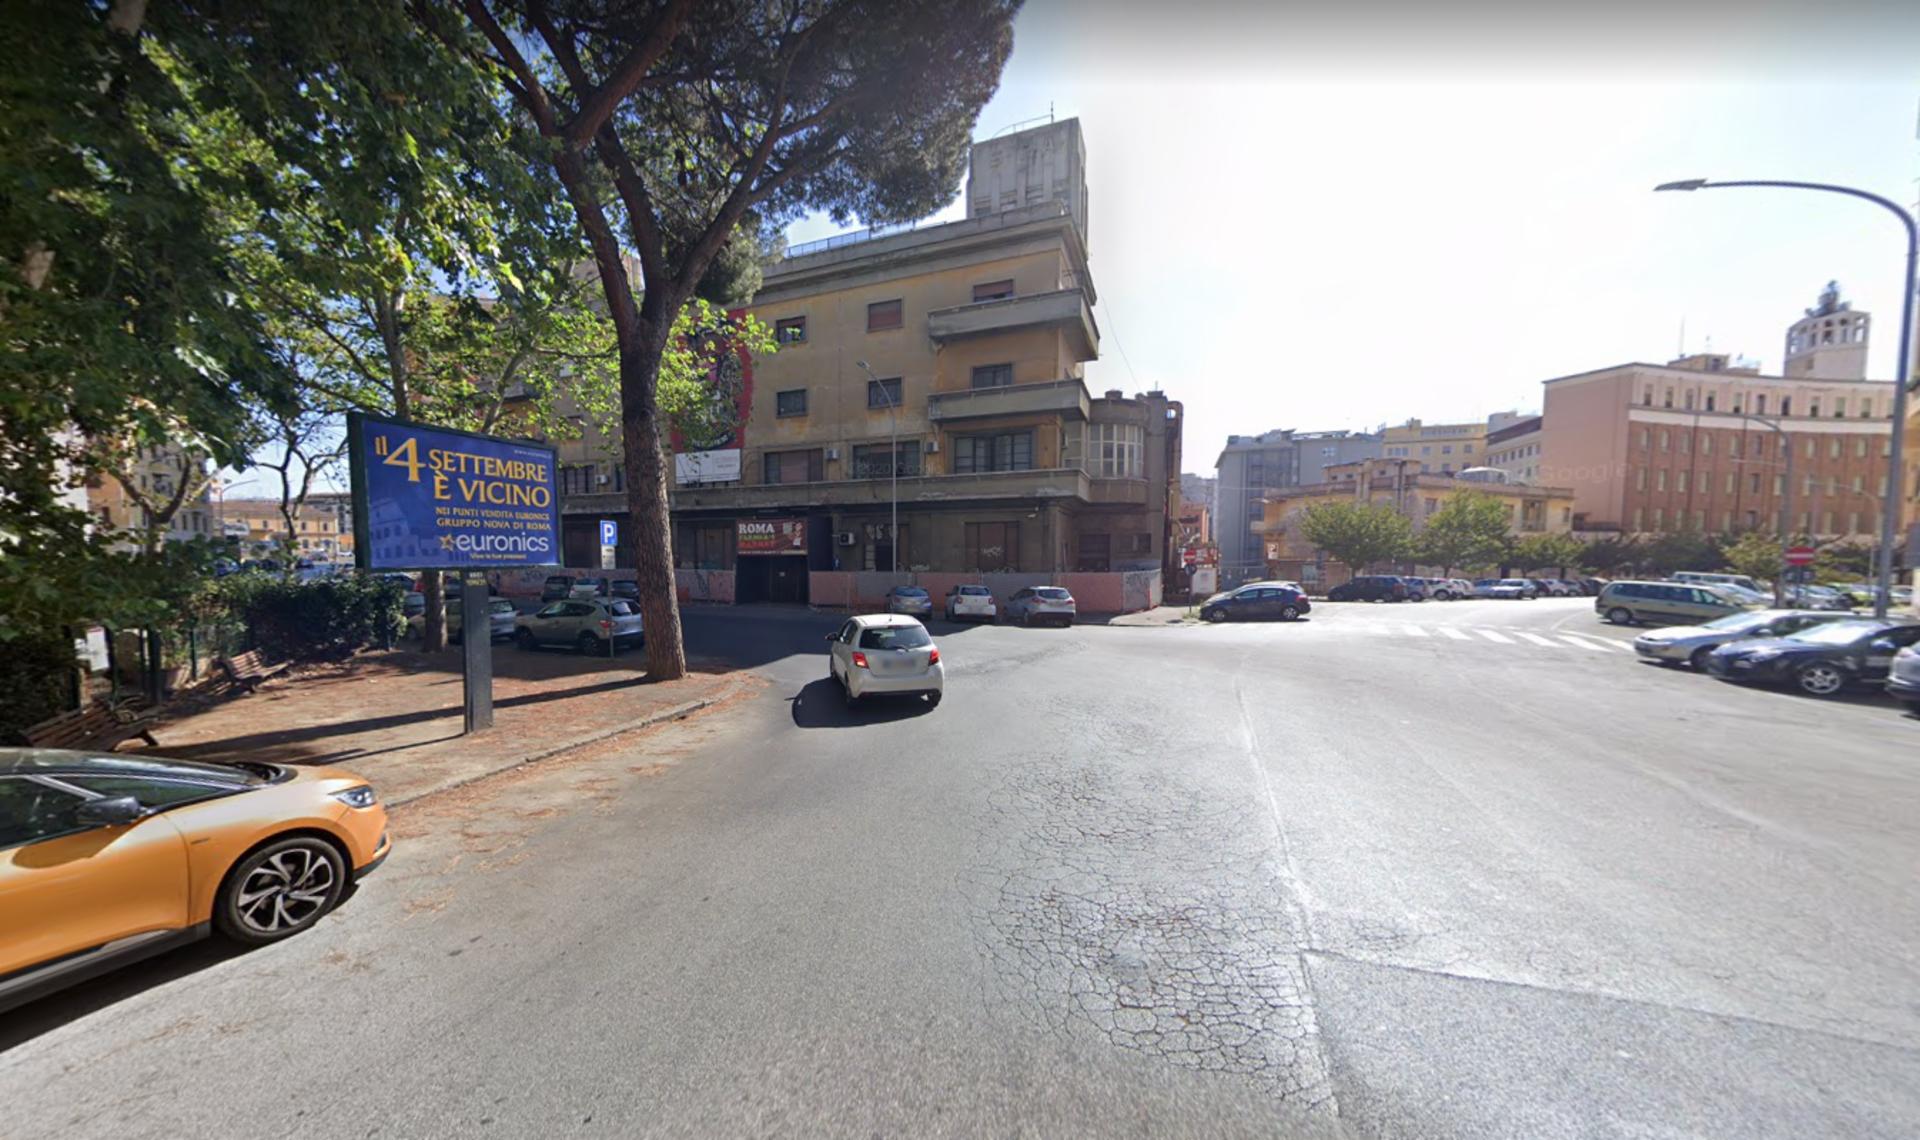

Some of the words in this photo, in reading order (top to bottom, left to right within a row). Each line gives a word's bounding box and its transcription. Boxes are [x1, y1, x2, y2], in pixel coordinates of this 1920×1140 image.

[382, 437, 427, 482] 4
[428, 449, 549, 483] SETTEMBRE
[434, 470, 451, 500] È
[457, 477, 551, 508] VICINO
[435, 506, 450, 516] NEI
[453, 507, 478, 517] PUNTI
[481, 509, 514, 519] VENDITA
[515, 511, 550, 521] EURONICS
[436, 518, 480, 529] GRUPPO
[484, 519, 511, 530] NOVA
[513, 521, 524, 530] DI
[526, 522, 552, 531] ROMA
[604, 523, 614, 543] P
[738, 523, 775, 534] ROMA
[455, 531, 550, 552] euronics
